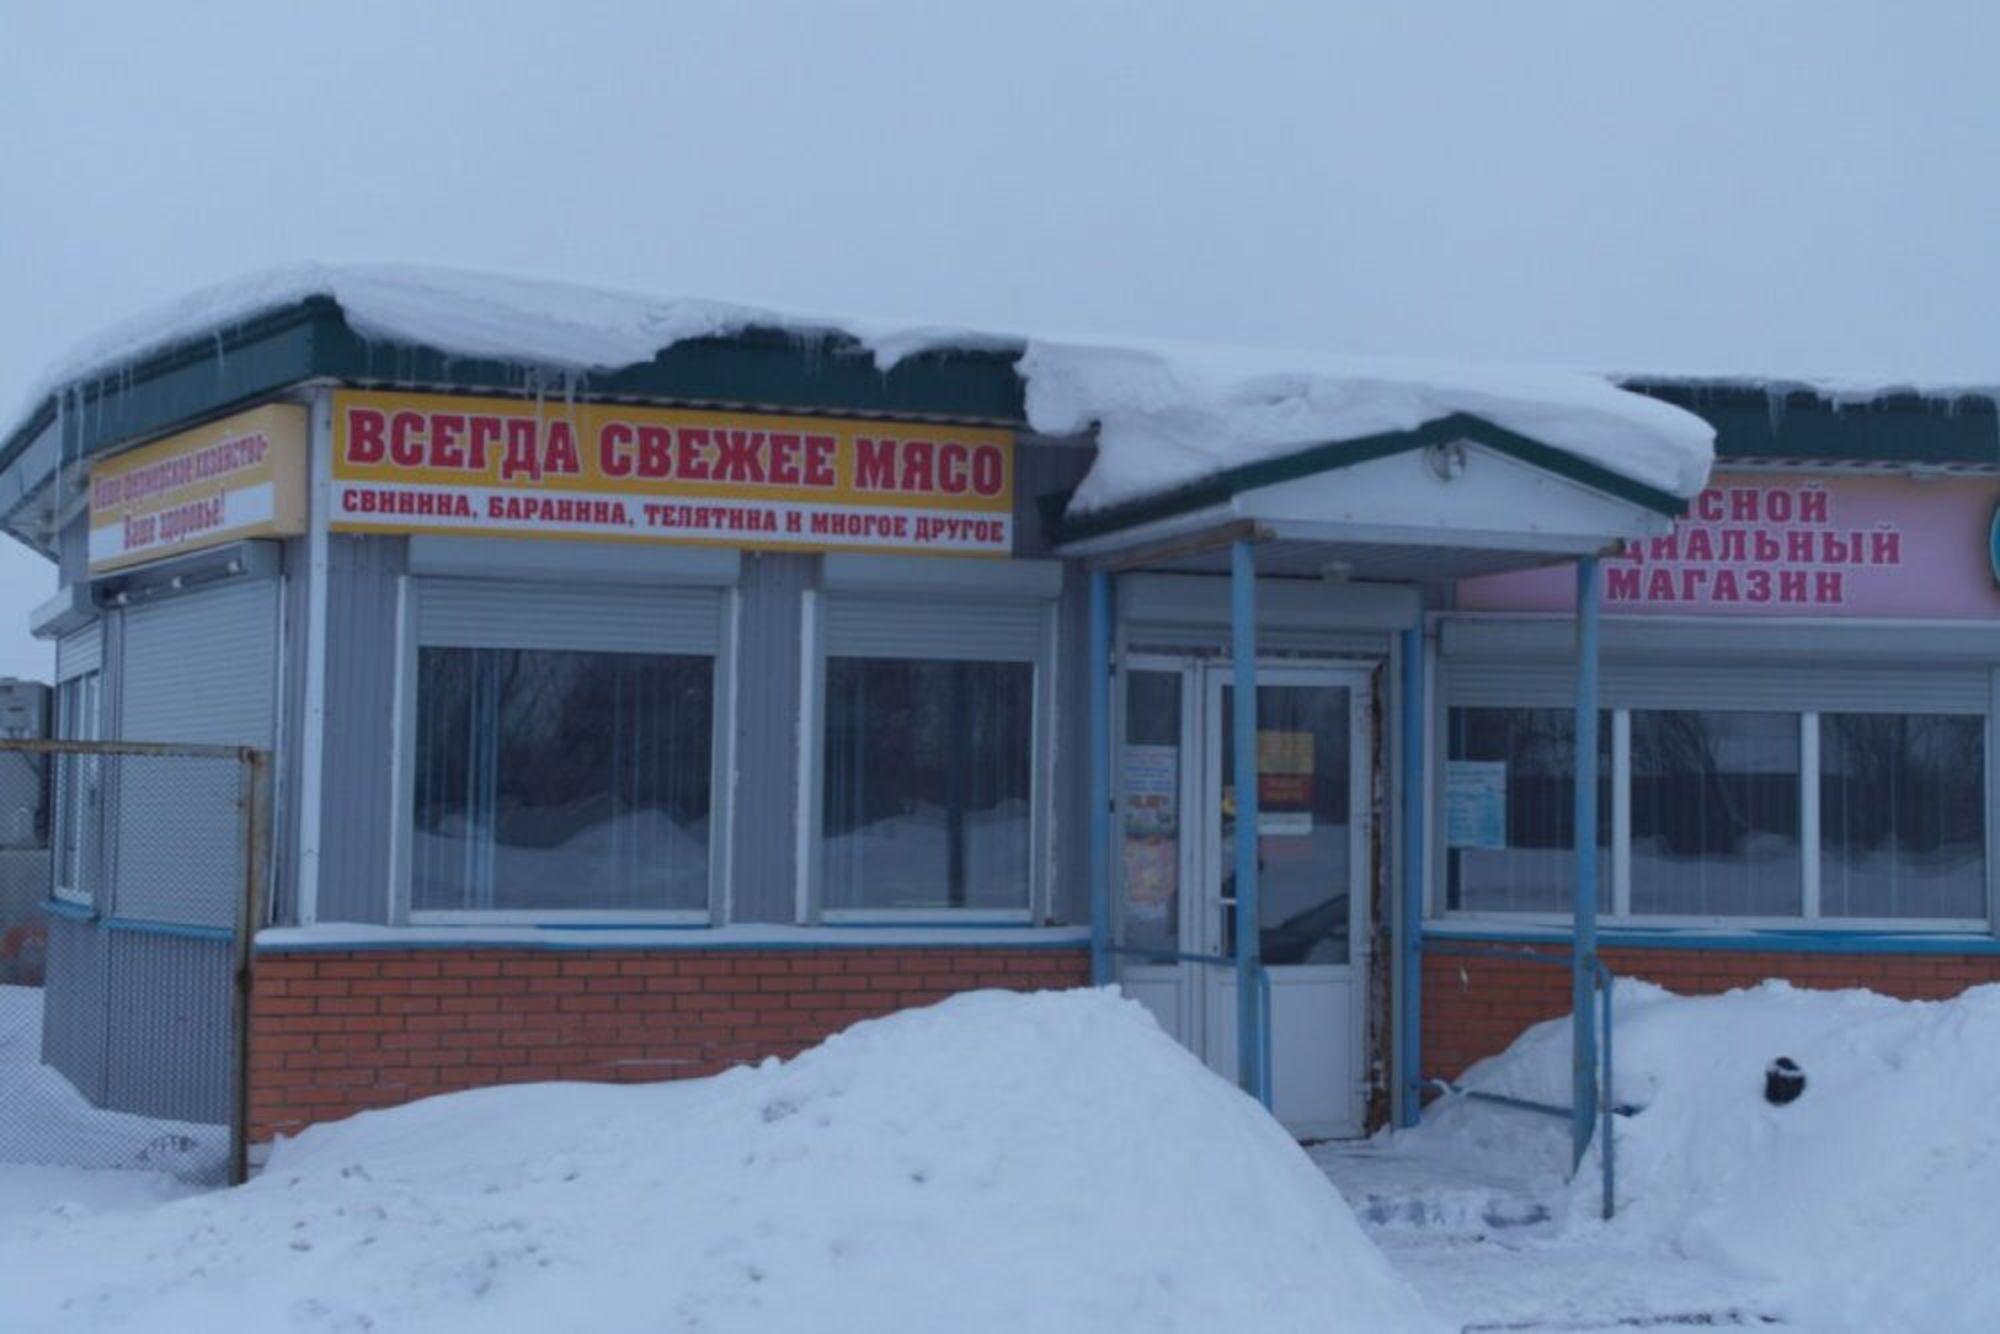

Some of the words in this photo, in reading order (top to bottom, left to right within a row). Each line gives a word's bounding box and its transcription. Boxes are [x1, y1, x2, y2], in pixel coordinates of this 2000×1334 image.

[346, 410, 580, 481] ВСЕГДА
[599, 424, 837, 487] СВЕЖЕЕ
[855, 439, 1004, 496] МЯСО
[343, 488, 478, 522] СВИНИНА,
[488, 495, 635, 529] БАРАНИНА,
[644, 504, 778, 534] ТЕЛЯТИНА
[786, 511, 803, 534] И
[810, 512, 908, 539] МНОГОЕ
[914, 517, 1005, 544] ДРУГОЕ
[1675, 483, 1828, 523] СНОЙ
[1606, 567, 1844, 604] МАГАЗИН
